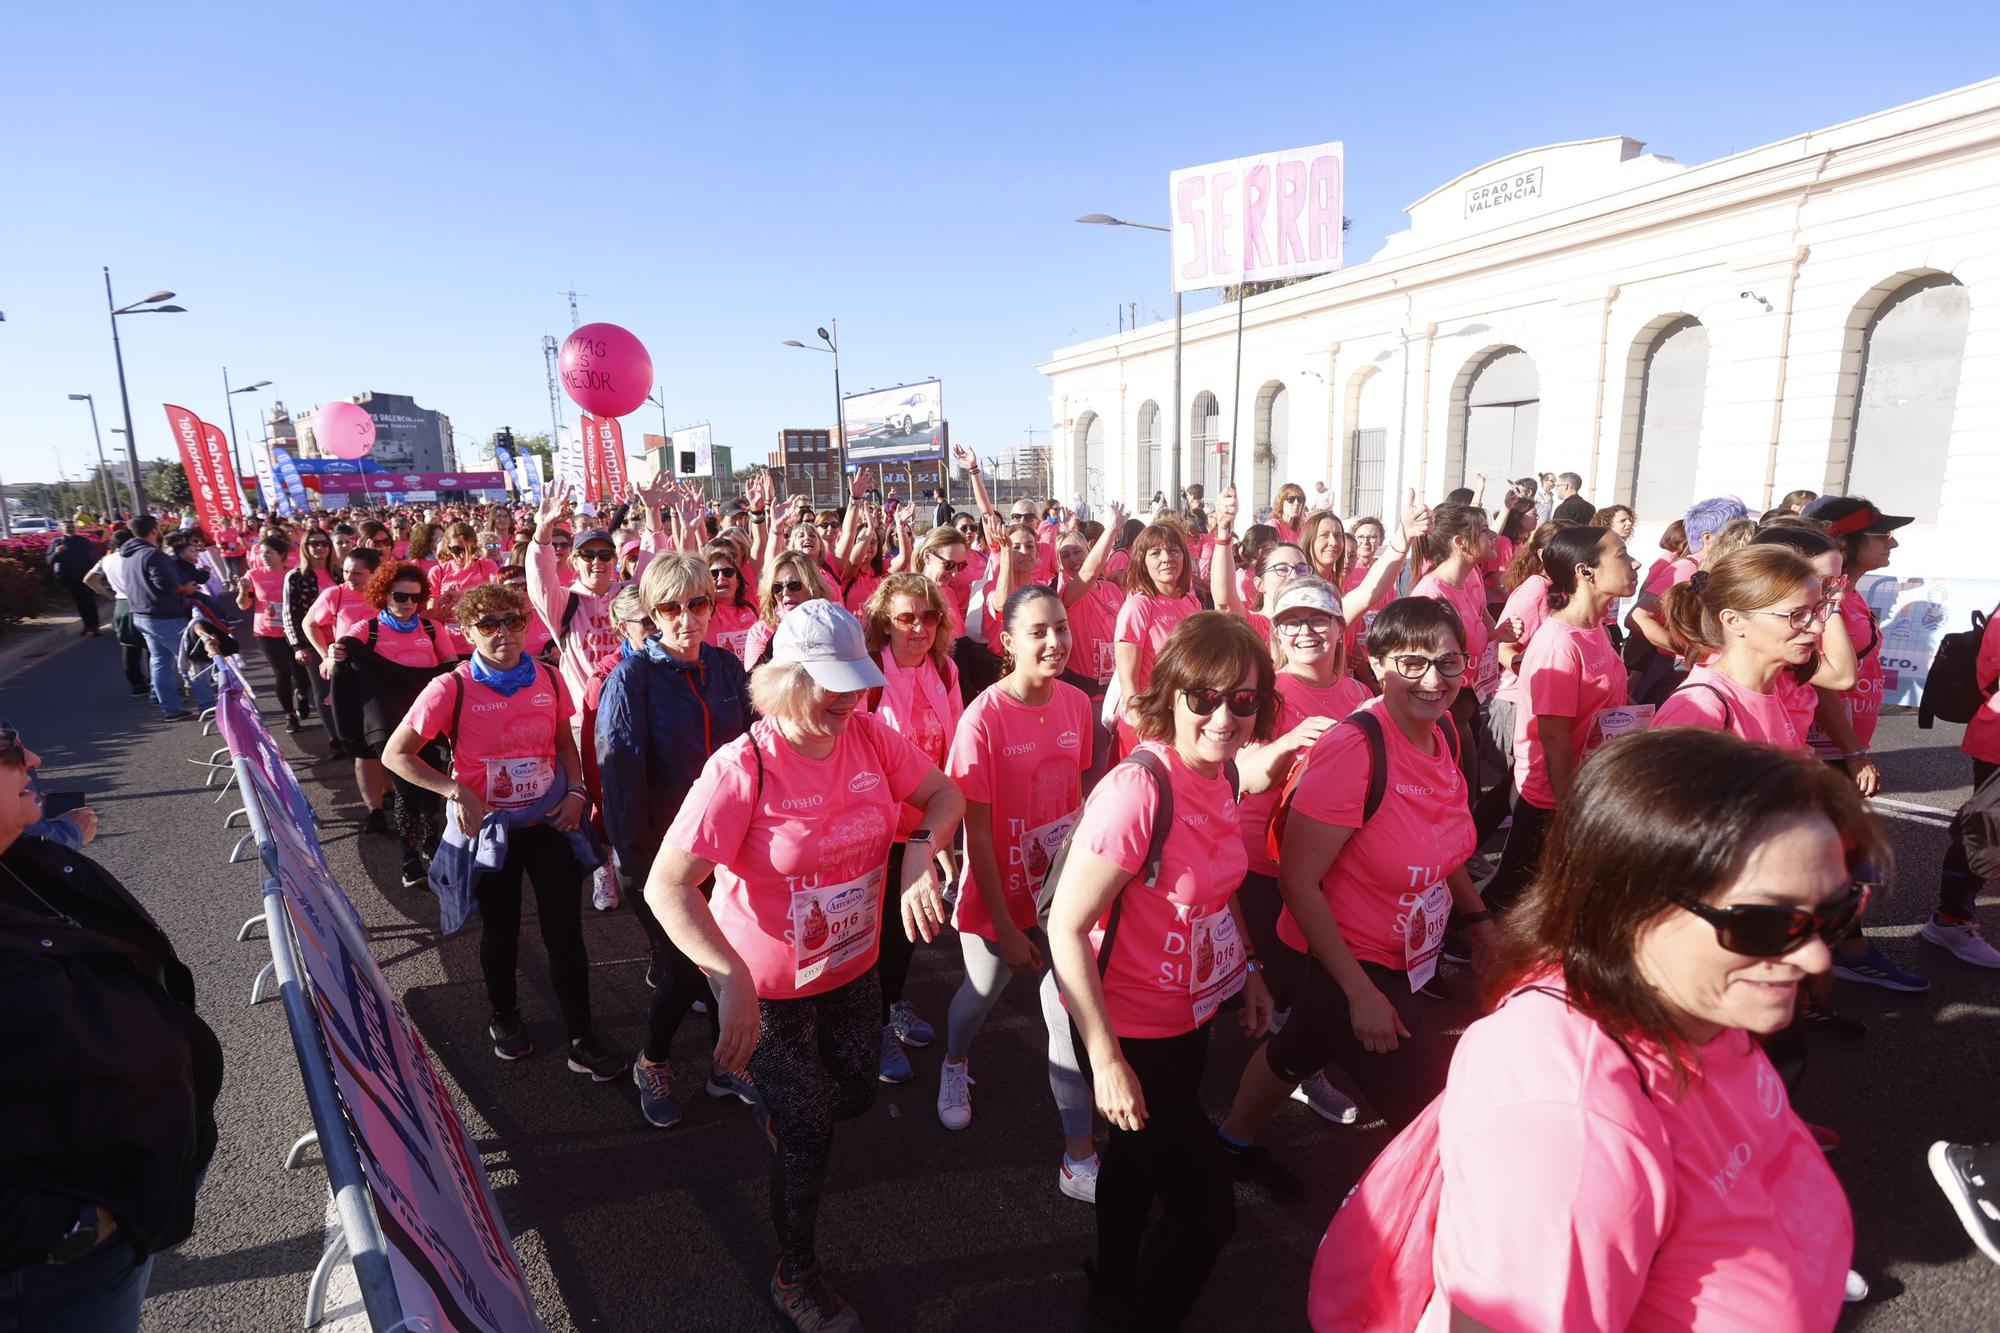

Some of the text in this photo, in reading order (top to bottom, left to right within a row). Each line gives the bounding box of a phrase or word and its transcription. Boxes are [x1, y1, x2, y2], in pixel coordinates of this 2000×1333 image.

[1472, 173, 1535, 201] GRAO DE
[1469, 185, 1536, 213] VALENCIA
[1177, 155, 1340, 280] SERRA
[562, 369, 616, 393] MEJOR
[1879, 655, 1918, 672] tro,
[472, 701, 508, 713] OYSHO
[1003, 742, 1036, 757] OYSHO
[515, 781, 538, 793] 016
[782, 794, 823, 810] OYSHO
[1407, 865, 1441, 888] TU
[831, 912, 859, 935] 016
[1428, 914, 1444, 935] 016
[1216, 942, 1236, 966] 016
